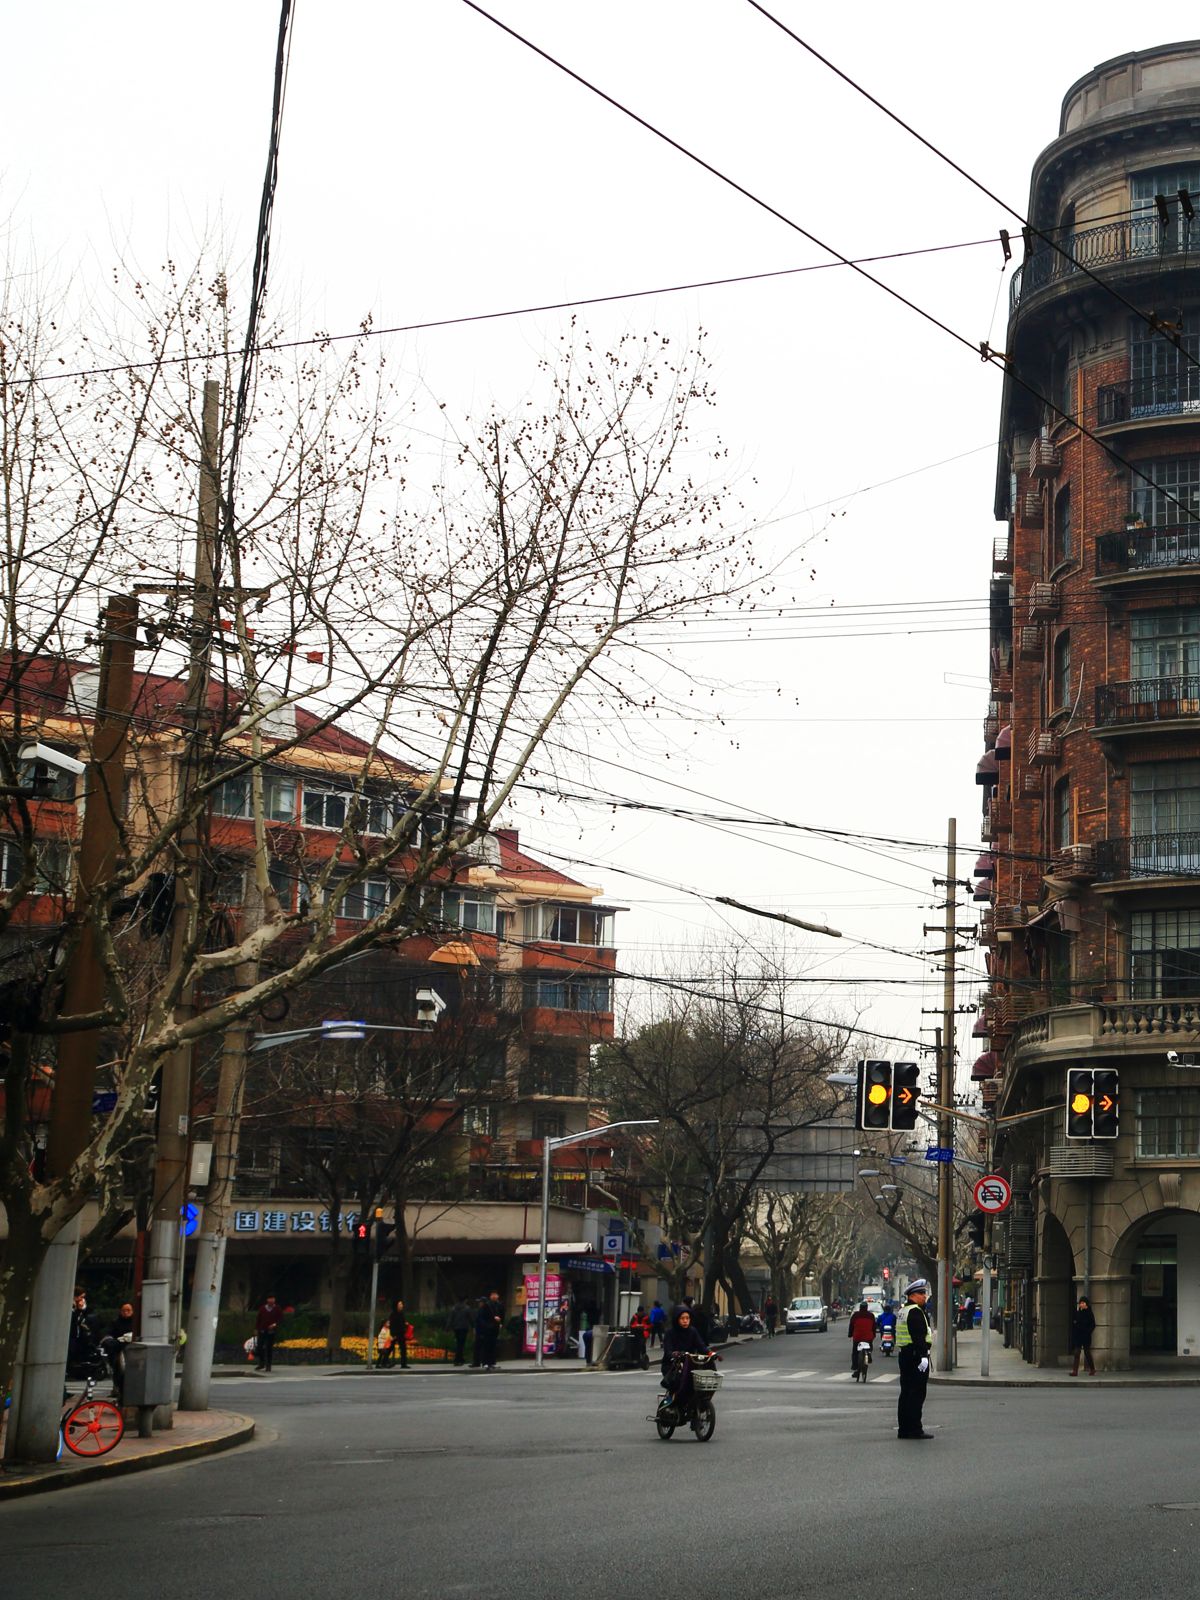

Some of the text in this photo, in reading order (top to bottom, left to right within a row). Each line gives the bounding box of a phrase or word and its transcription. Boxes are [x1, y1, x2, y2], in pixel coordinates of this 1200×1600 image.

[227, 1210, 362, 1232] 国建设银行
[89, 1256, 137, 1264] STARBUCK
